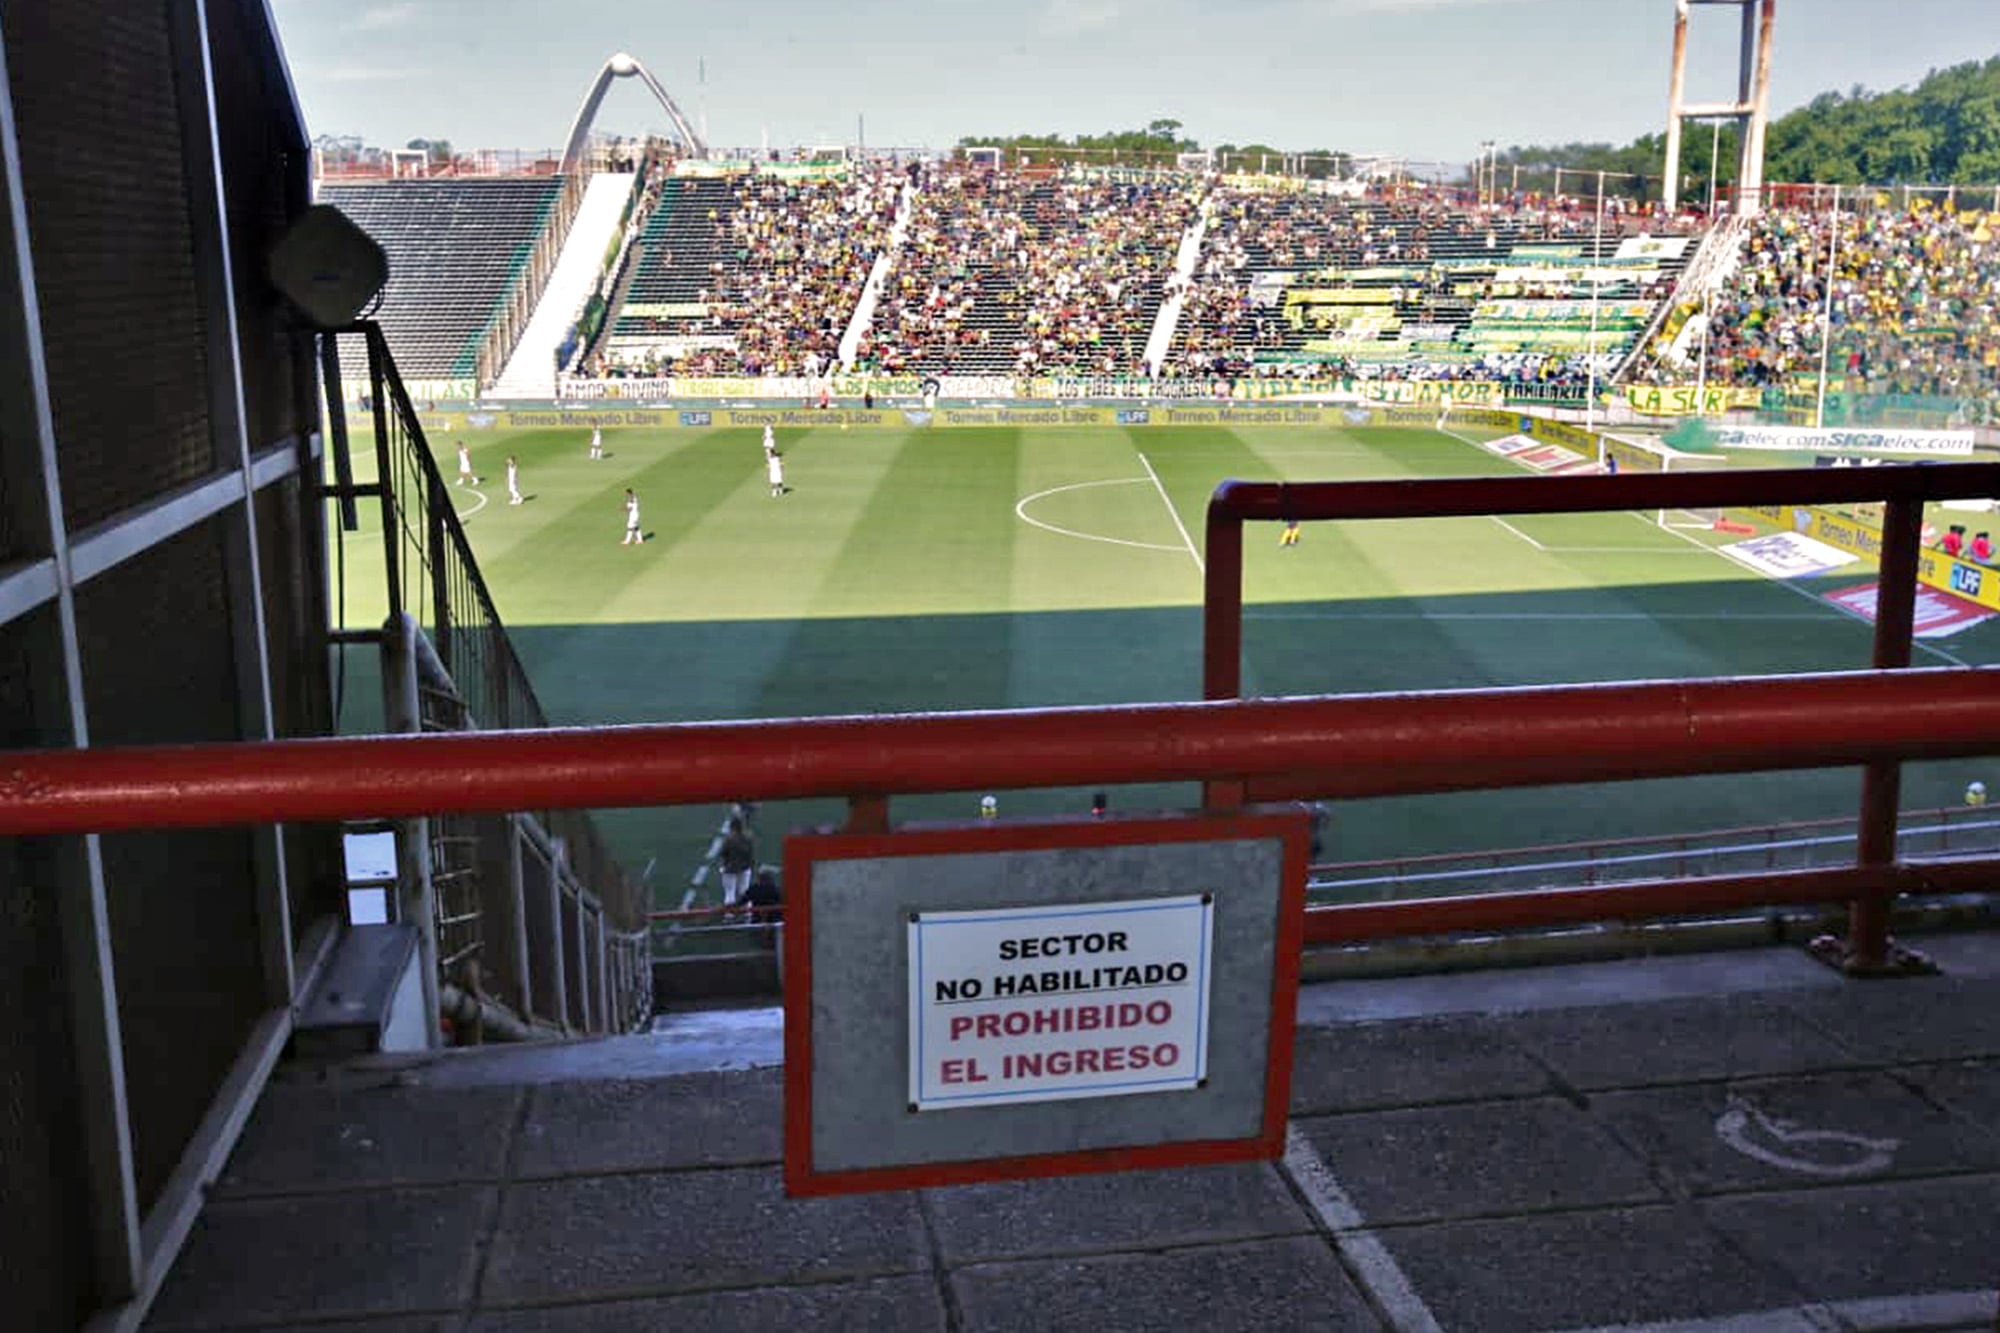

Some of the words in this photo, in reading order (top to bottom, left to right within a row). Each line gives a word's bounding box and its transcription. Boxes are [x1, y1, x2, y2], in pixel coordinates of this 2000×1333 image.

[835, 380, 862, 395] LOS
[1628, 389, 1662, 411] LA
[1672, 390, 1734, 412] SUR
[508, 413, 557, 426] Torneo
[625, 411, 661, 425] Libre
[730, 411, 777, 424] Torneo
[782, 411, 843, 424] Mercado
[847, 411, 882, 424] Libre
[997, 411, 1059, 423] Mercado
[1062, 410, 1099, 423] Libre
[999, 932, 1127, 960] SECTOR
[935, 979, 982, 1001] NO
[994, 962, 1188, 996] HABILITADO
[950, 1000, 1172, 1041] PROHIBIDO
[941, 1058, 988, 1085] EL
[1002, 1043, 1179, 1079] INGRESO
